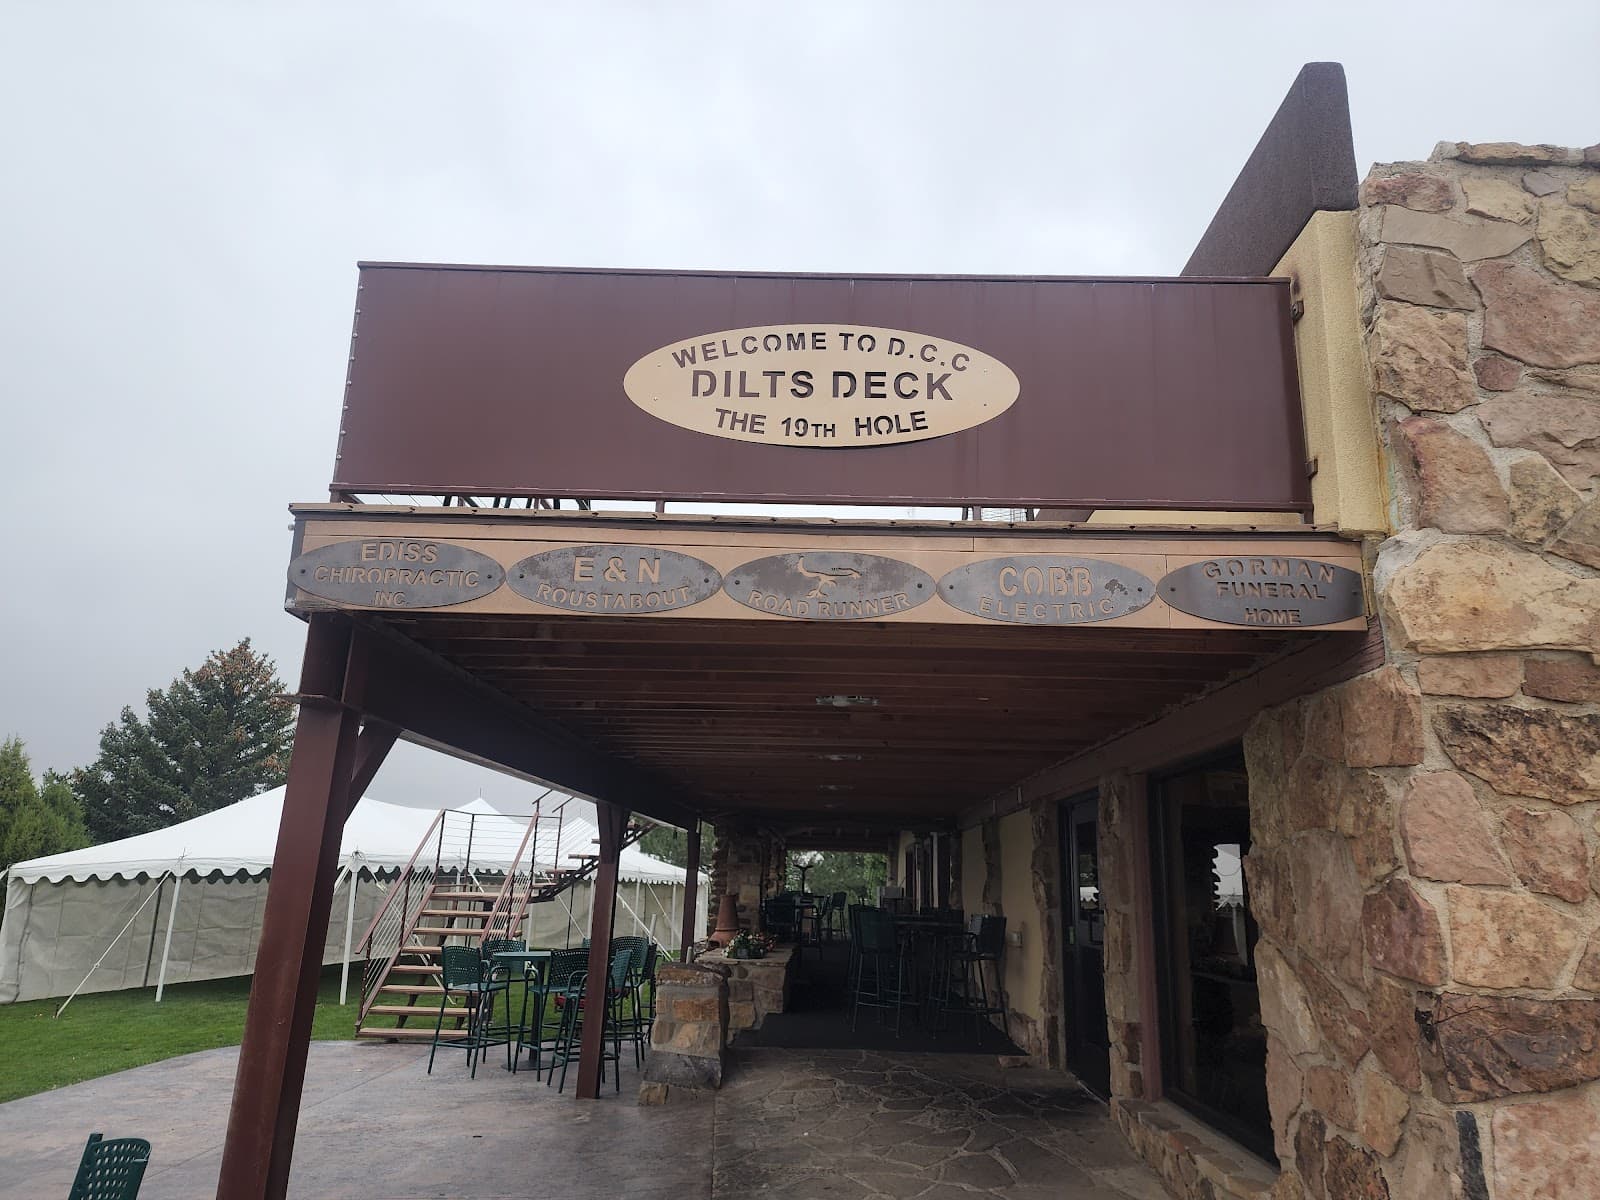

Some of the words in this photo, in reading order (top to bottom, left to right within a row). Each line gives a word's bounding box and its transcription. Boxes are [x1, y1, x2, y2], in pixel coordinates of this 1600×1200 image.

[672, 332, 827, 368] WELCOME
[838, 333, 876, 353] TO
[887, 337, 970, 372] D.C.C
[691, 370, 815, 399] DILTS
[831, 370, 954, 401] DECK
[714, 408, 767, 435] THE
[780, 417, 836, 438] 19TH
[854, 411, 929, 437] HOLE
[361, 541, 438, 563] EDISS
[314, 566, 479, 588] CHIROPRACTIC
[573, 556, 594, 582] E
[603, 556, 627, 583] &
[638, 557, 661, 583] N
[999, 566, 1093, 596] COBB
[1202, 559, 1336, 584] GORMAN
[536, 583, 689, 609] ROUSTABOUT
[749, 590, 809, 616] ROAD
[817, 592, 911, 617] RUNNER
[1216, 581, 1327, 600] FUNERAL
[980, 597, 1113, 619] ELECTRIC
[1244, 608, 1301, 624] HOME
